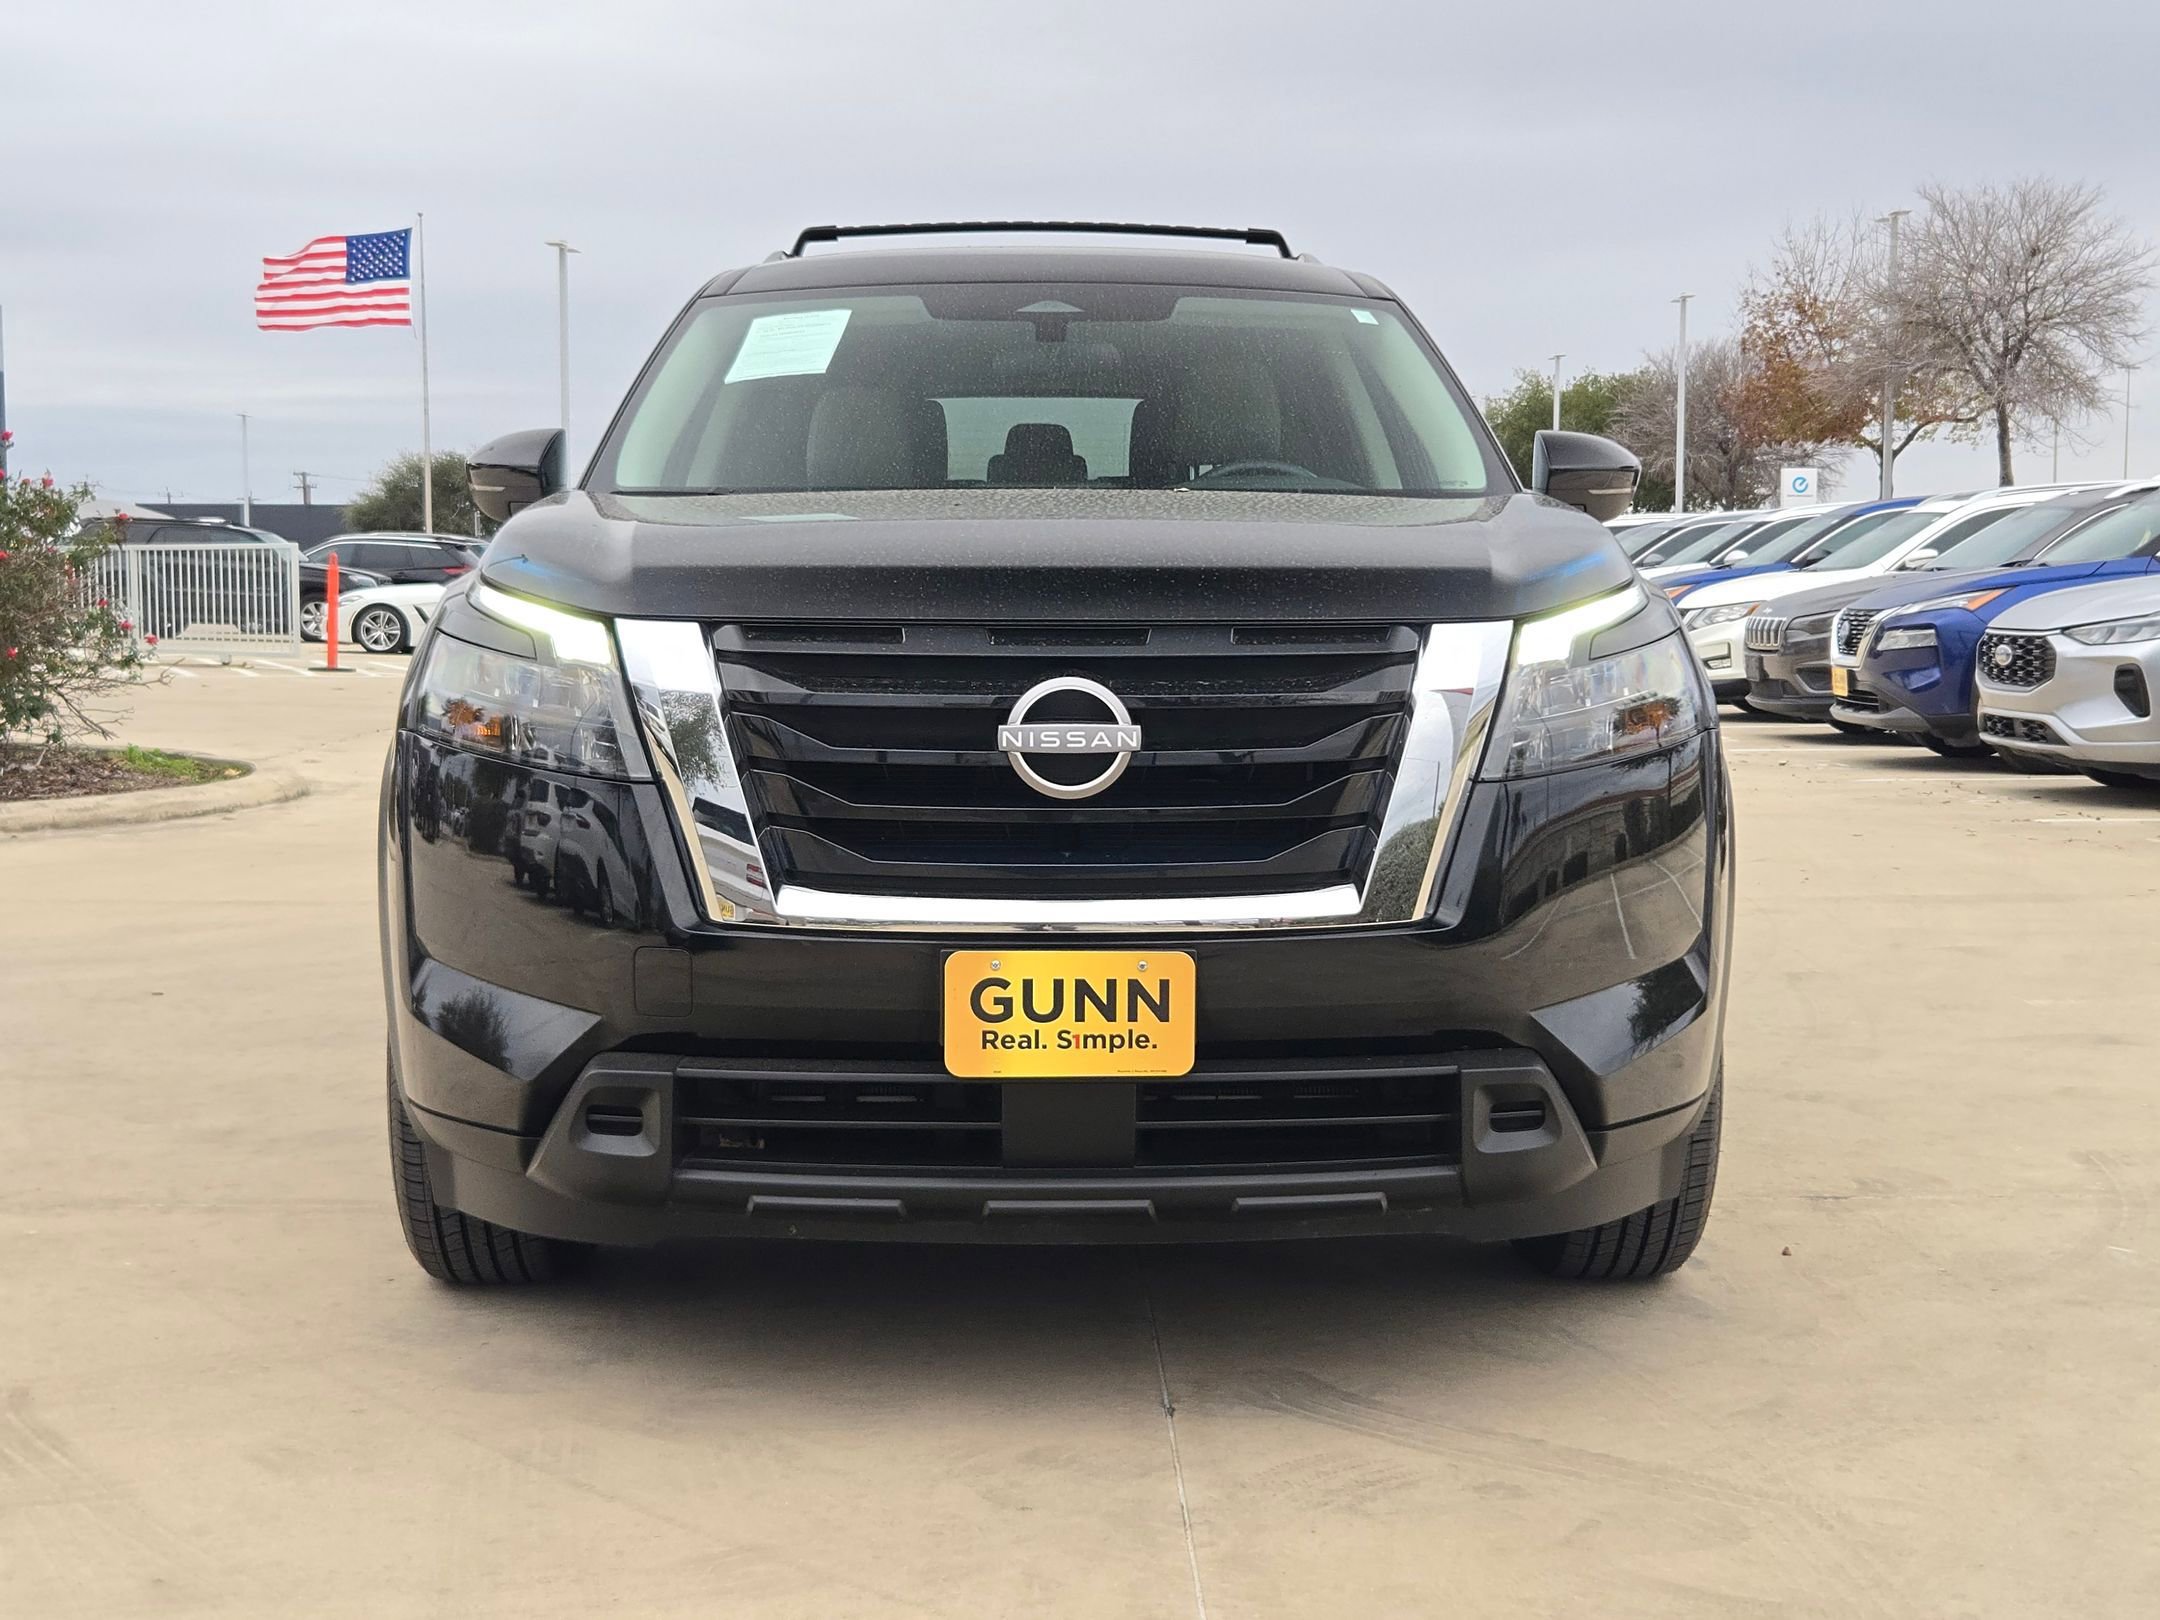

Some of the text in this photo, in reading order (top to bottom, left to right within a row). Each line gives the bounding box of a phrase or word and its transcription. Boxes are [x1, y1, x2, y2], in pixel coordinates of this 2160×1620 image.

[1002, 731, 1137, 747] NISSAN
[970, 977, 1170, 1023] GUNN
[981, 1029, 1047, 1050] Real.
